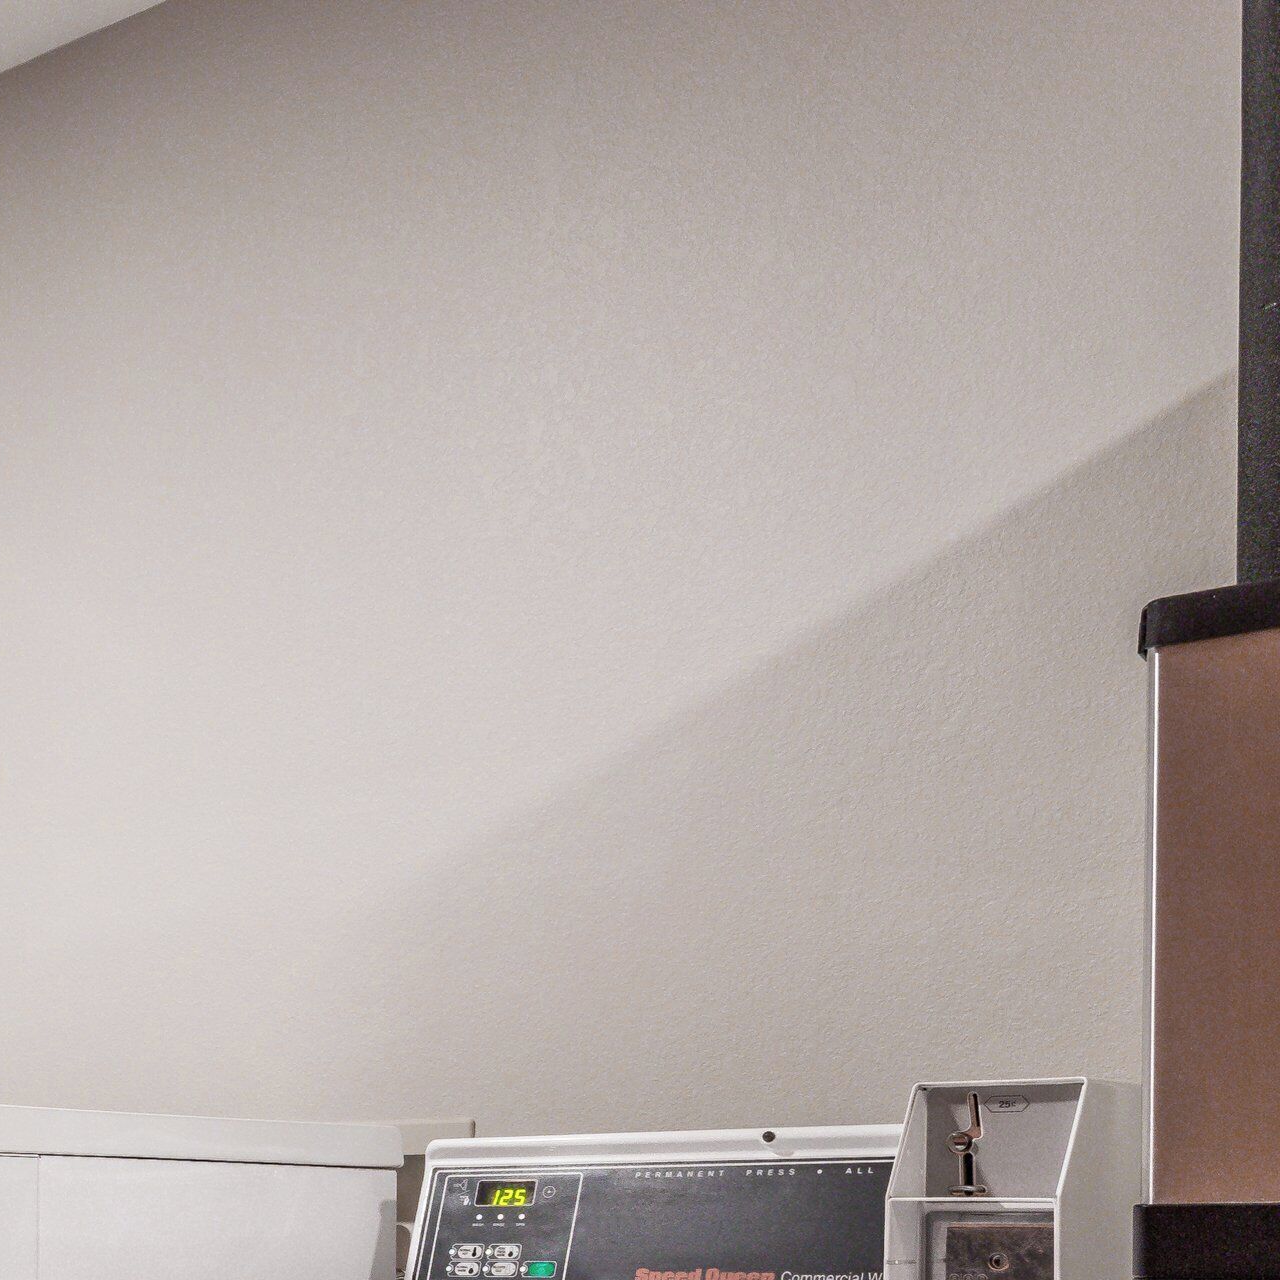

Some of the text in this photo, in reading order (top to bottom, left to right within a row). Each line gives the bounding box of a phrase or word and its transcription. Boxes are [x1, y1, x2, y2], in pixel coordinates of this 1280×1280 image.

[635, 1170, 725, 1178] PERMANENT
[746, 1168, 796, 1176] PRESS
[493, 1188, 526, 1205] 125
